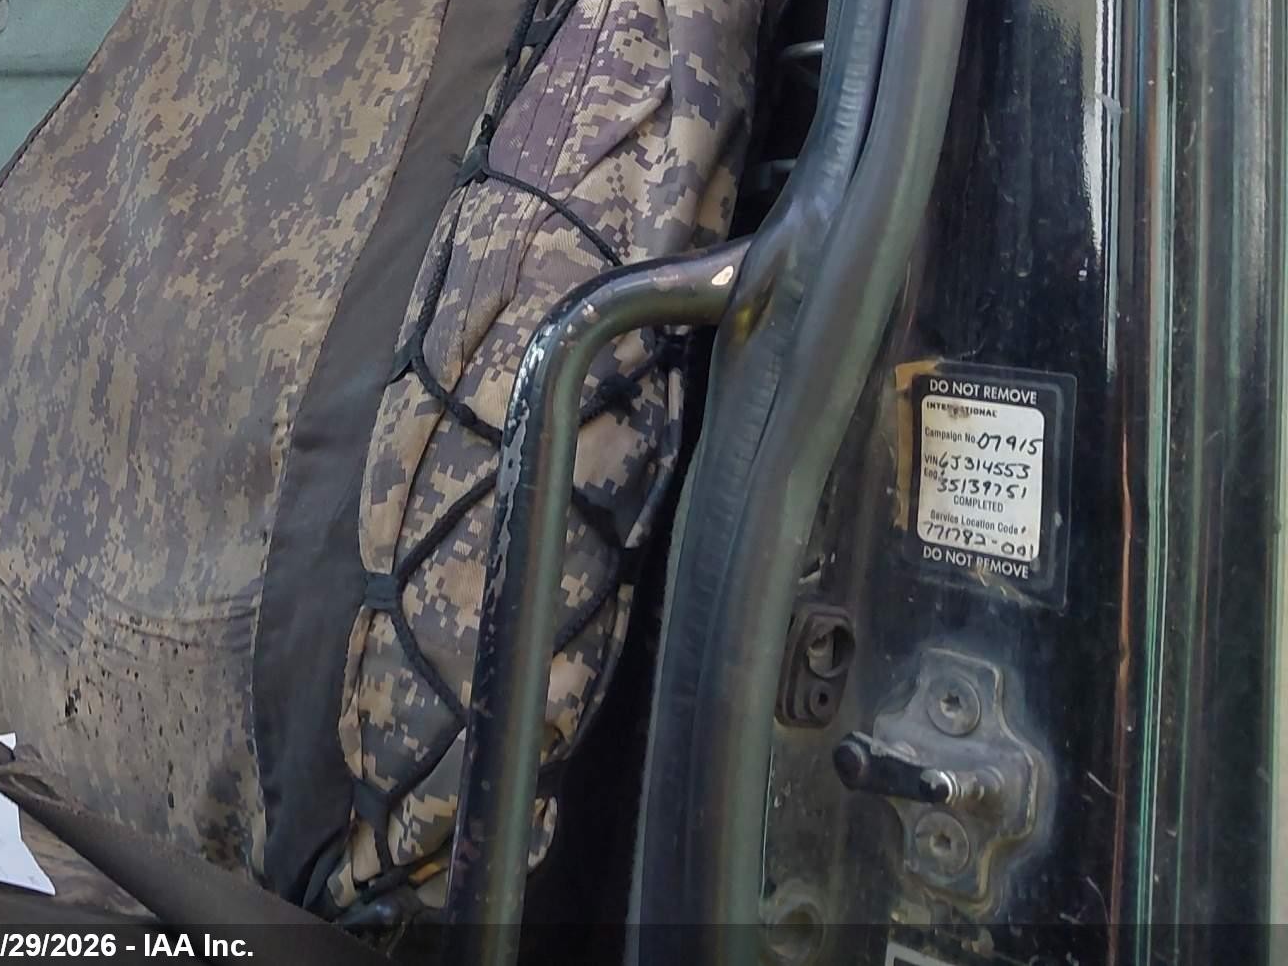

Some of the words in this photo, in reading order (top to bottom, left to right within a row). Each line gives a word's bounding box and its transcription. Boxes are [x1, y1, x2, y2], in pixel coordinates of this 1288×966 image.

[929, 379, 949, 394] DO
[952, 381, 980, 397] NOT
[983, 385, 1038, 405] REMOVE
[926, 401, 998, 419] INTETIONAL
[924, 426, 963, 443] Campaign
[924, 454, 938, 467] VIN
[953, 495, 1004, 513] COMPLETED
[930, 509, 959, 524] Service
[961, 516, 995, 531] Location
[997, 522, 1019, 535] Code
[922, 545, 942, 561] DO
[945, 550, 973, 567] NOT
[976, 557, 1029, 579] REMOVE
